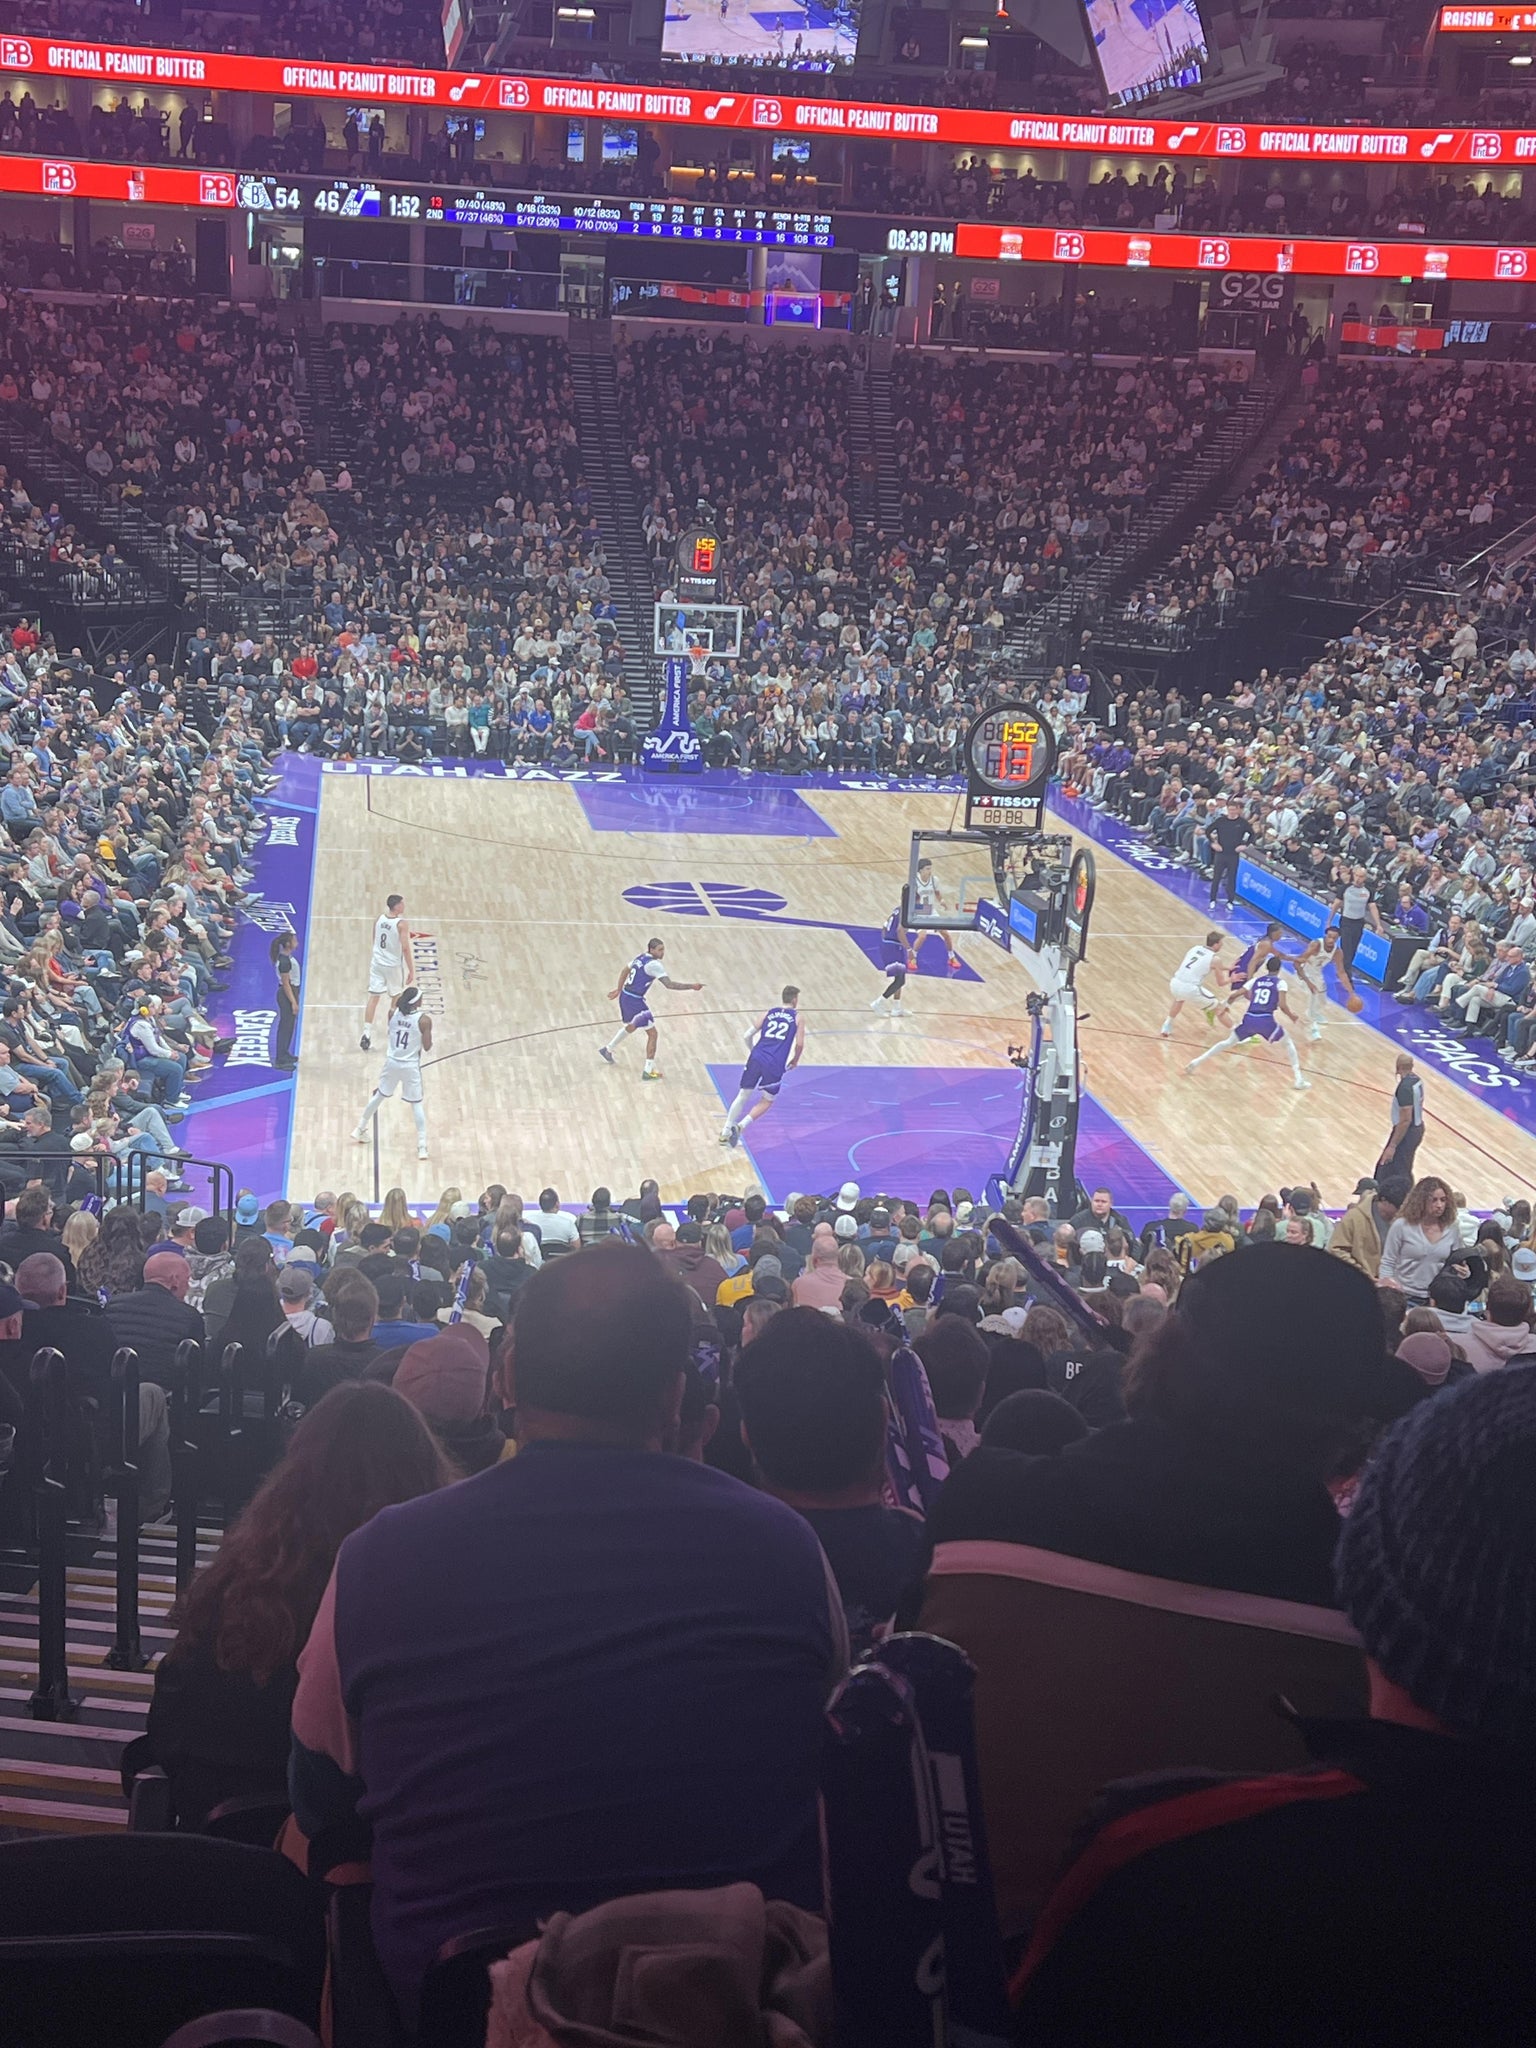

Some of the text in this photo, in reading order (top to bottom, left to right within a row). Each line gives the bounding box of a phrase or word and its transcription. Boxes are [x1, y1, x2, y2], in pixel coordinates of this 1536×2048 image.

[1443, 11, 1494, 27] RAISING
[1498, 14, 1521, 31] THE
[1, 38, 33, 67] PB
[48, 47, 205, 80] OFFICIAL PEANUT BUTTER
[810, 62, 823, 71] UTA
[283, 67, 436, 97] OFFICIAL PEANUT BUTTER
[499, 79, 529, 107] PB
[543, 86, 691, 116] OFFICIAL PEANUT BUTTER
[753, 99, 782, 126] PB
[796, 105, 938, 133] OFFICIAL PEANUT BUTTER
[1010, 120, 1154, 145] OFFICIAL PEANUT BUTTER
[1216, 127, 1247, 153] PB
[1260, 132, 1408, 155] OFFICIAL PEANUT BUTTER
[1471, 133, 1501, 159] PB
[43, 163, 76, 192] PB
[200, 175, 233, 203] PB
[275, 187, 300, 210] 54
[314, 190, 340, 212] 46
[389, 194, 420, 217] 1:52
[430, 196, 443, 207] 13
[426, 208, 444, 220] 2ND
[455, 199, 480, 209] 19/40
[516, 203, 536, 213] 6/18
[537, 205, 561, 216] (33%)
[573, 207, 596, 217] 10/12
[597, 208, 621, 220] (83%)
[633, 211, 640, 221] 5
[652, 213, 662, 222] 19
[671, 214, 684, 224] 24
[694, 216, 703, 226] 11
[715, 217, 722, 227] 3
[736, 219, 742, 228] 1
[756, 219, 763, 229] 4
[776, 221, 786, 231] 31
[794, 222, 809, 232] 122
[814, 224, 830, 233] 108
[693, 207, 705, 215] AST
[713, 208, 725, 217] STL
[455, 212, 829, 245] 17/37 (46%) 5/17 (29%) 7/10 (70%) 2 10 12 15 3 2 3 16 108 122
[888, 229, 954, 253] 08:33 PM
[1054, 232, 1085, 259] PB
[1199, 239, 1230, 267] PB
[1345, 245, 1379, 272] PB
[1494, 250, 1528, 277] PB
[973, 282, 997, 292] G2G
[1220, 272, 1284, 299] G2G
[1262, 301, 1280, 309] BAR
[690, 577, 717, 585] TISSOT
[672, 689, 680, 726] AMERICA
[1002, 721, 1039, 743] 1:52
[322, 762, 626, 783] UTAH JAZZ
[999, 742, 1033, 781] 13
[993, 797, 1041, 808] TISSOT
[264, 816, 301, 846] SEATGEEK
[380, 933, 387, 949] 8
[1185, 956, 1198, 969] 2
[413, 942, 445, 1015] DELTA CENTER
[1253, 988, 1271, 1005] 19
[223, 1009, 277, 1068] SEATGEEK
[396, 1030, 409, 1049] 14
[765, 1020, 789, 1040] 22
[1411, 1039, 1520, 1087] PACS
[1008, 1097, 1029, 1169] AMERICA
[944, 1815, 977, 1884] UTAH
